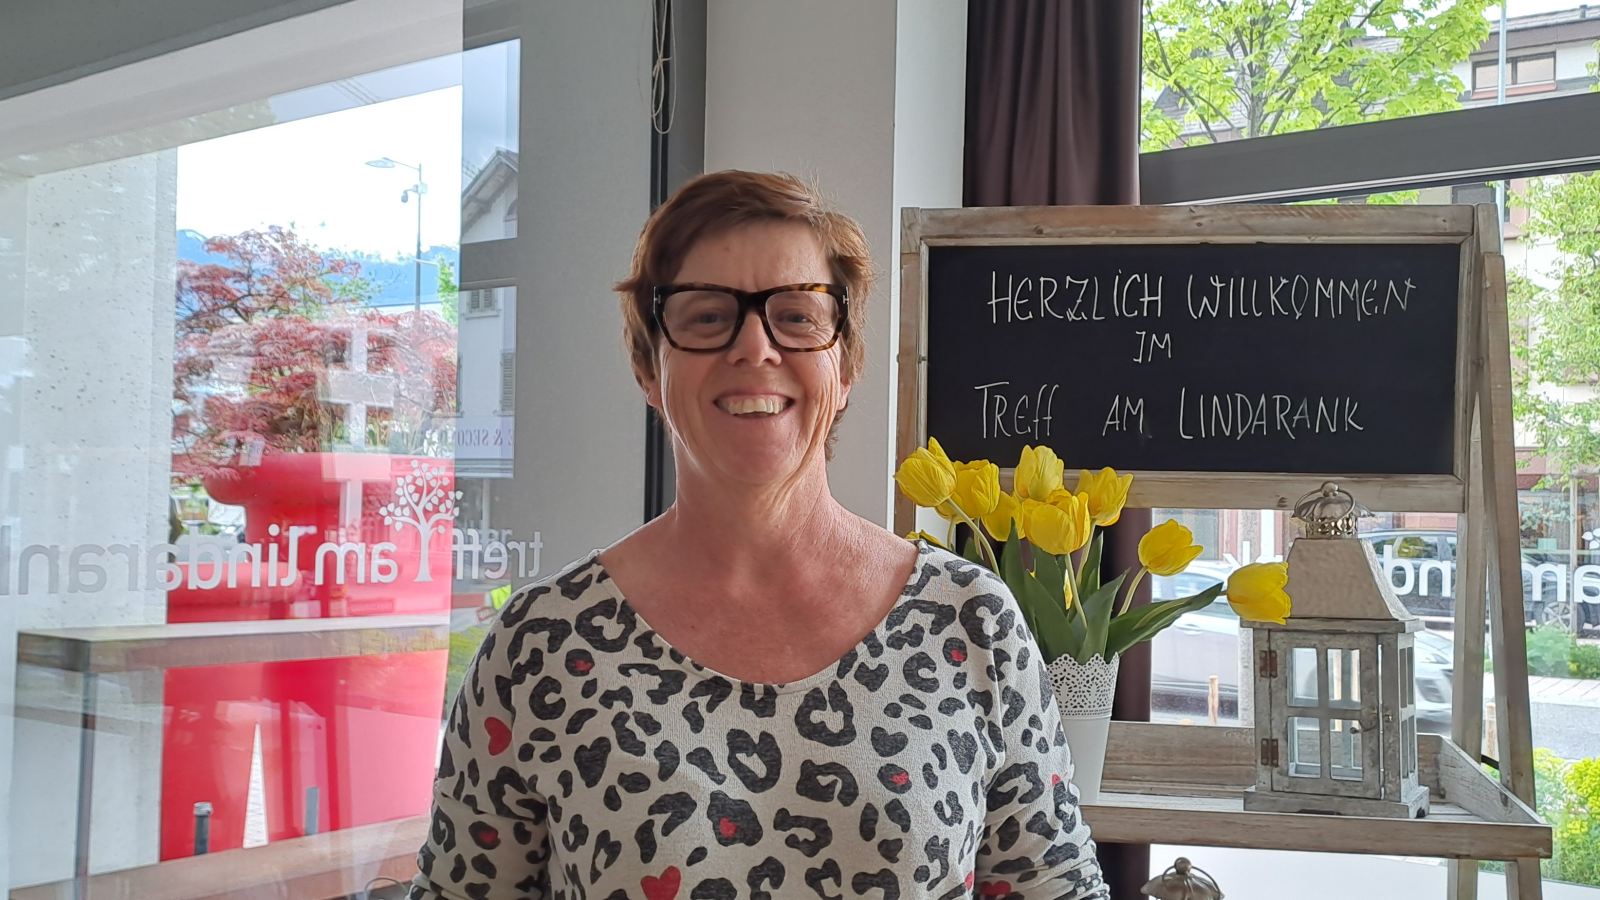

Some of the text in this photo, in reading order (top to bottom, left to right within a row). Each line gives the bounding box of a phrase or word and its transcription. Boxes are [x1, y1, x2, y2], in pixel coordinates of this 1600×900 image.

[987, 268, 1417, 324] HERZLICH WILLKOMMEN
[1132, 330, 1172, 364] IM
[1102, 394, 1144, 437] AM
[1179, 387, 1364, 441] LINDARANK
